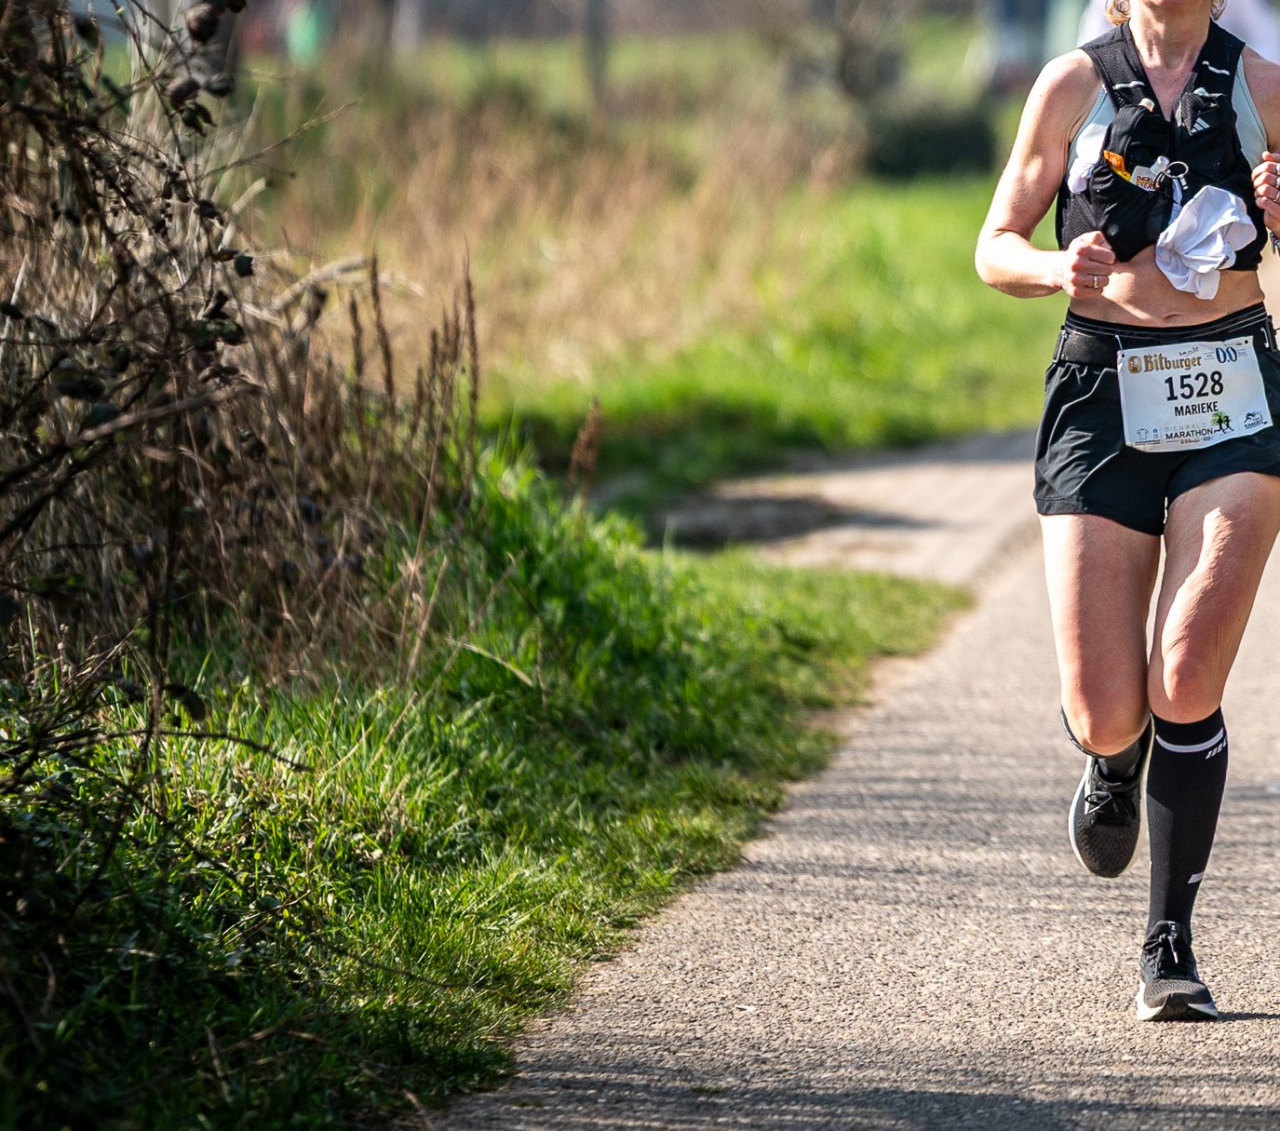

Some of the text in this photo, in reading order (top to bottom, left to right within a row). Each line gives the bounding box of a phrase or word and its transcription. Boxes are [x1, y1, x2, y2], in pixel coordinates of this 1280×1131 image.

[1143, 353, 1202, 373] Bitburger
[1215, 346, 1238, 364] 0.0
[1164, 370, 1224, 402] 1528
[1174, 401, 1219, 417] MARIEKE
[1165, 427, 1214, 440] MARATHON
